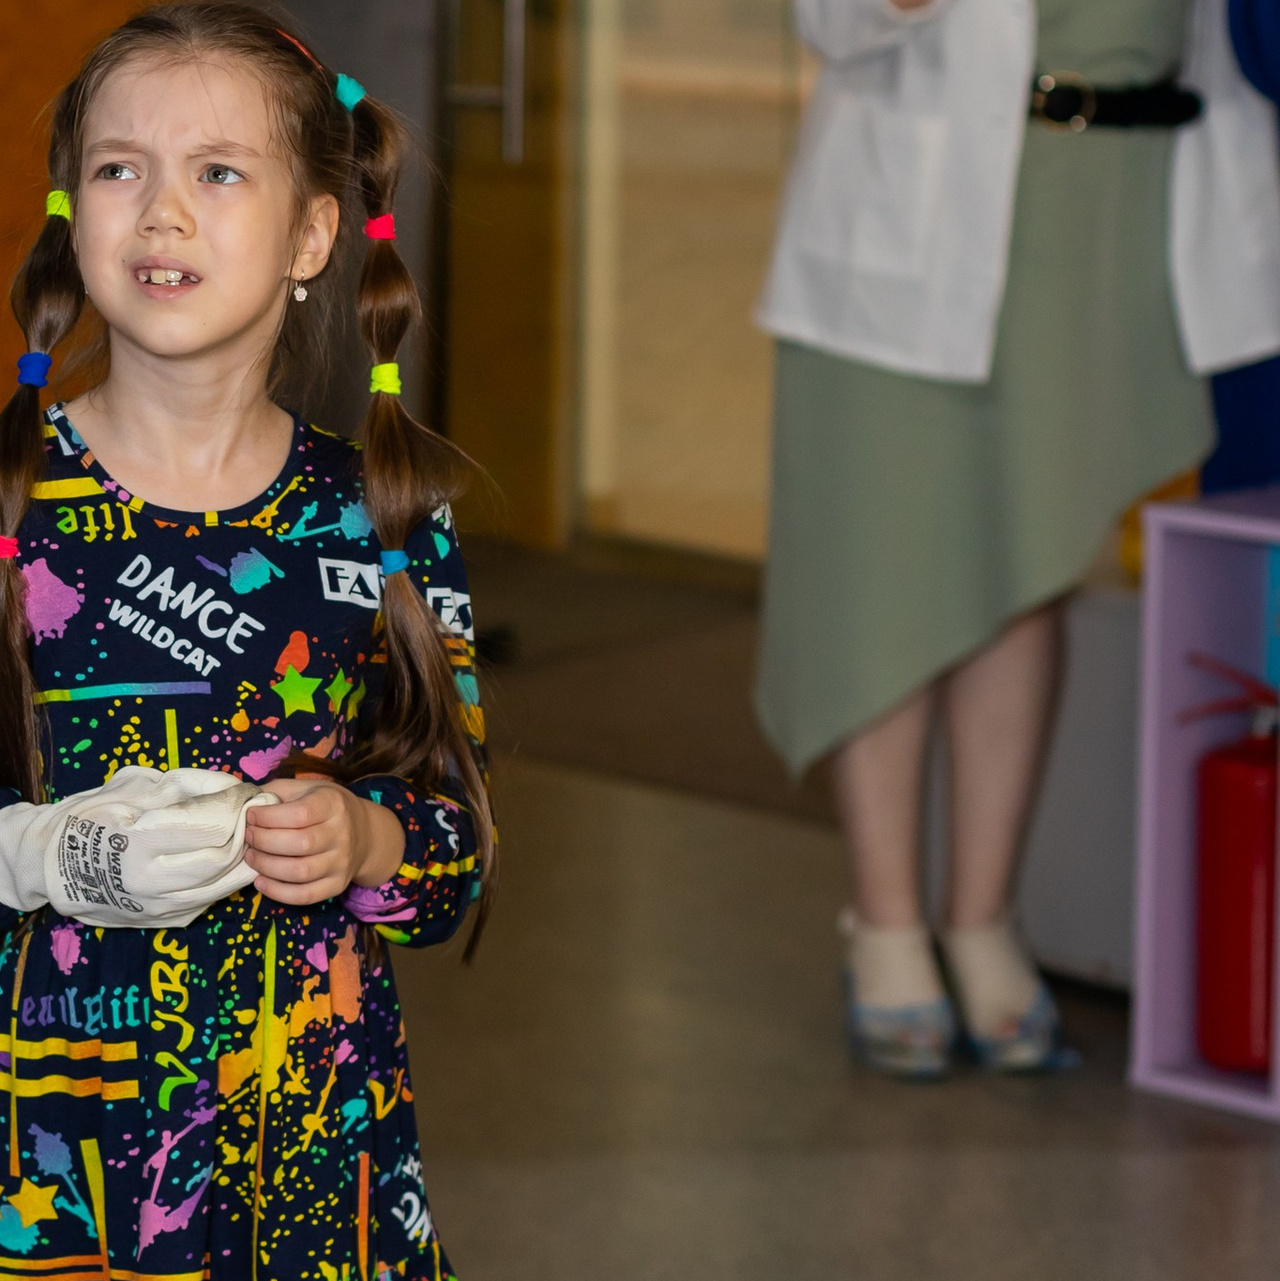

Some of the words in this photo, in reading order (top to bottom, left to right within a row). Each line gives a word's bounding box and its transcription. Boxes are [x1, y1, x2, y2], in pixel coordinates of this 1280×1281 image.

[108, 599, 221, 677] WILDCAT
[116, 554, 266, 654] DANCE
[92, 825, 106, 865] White
